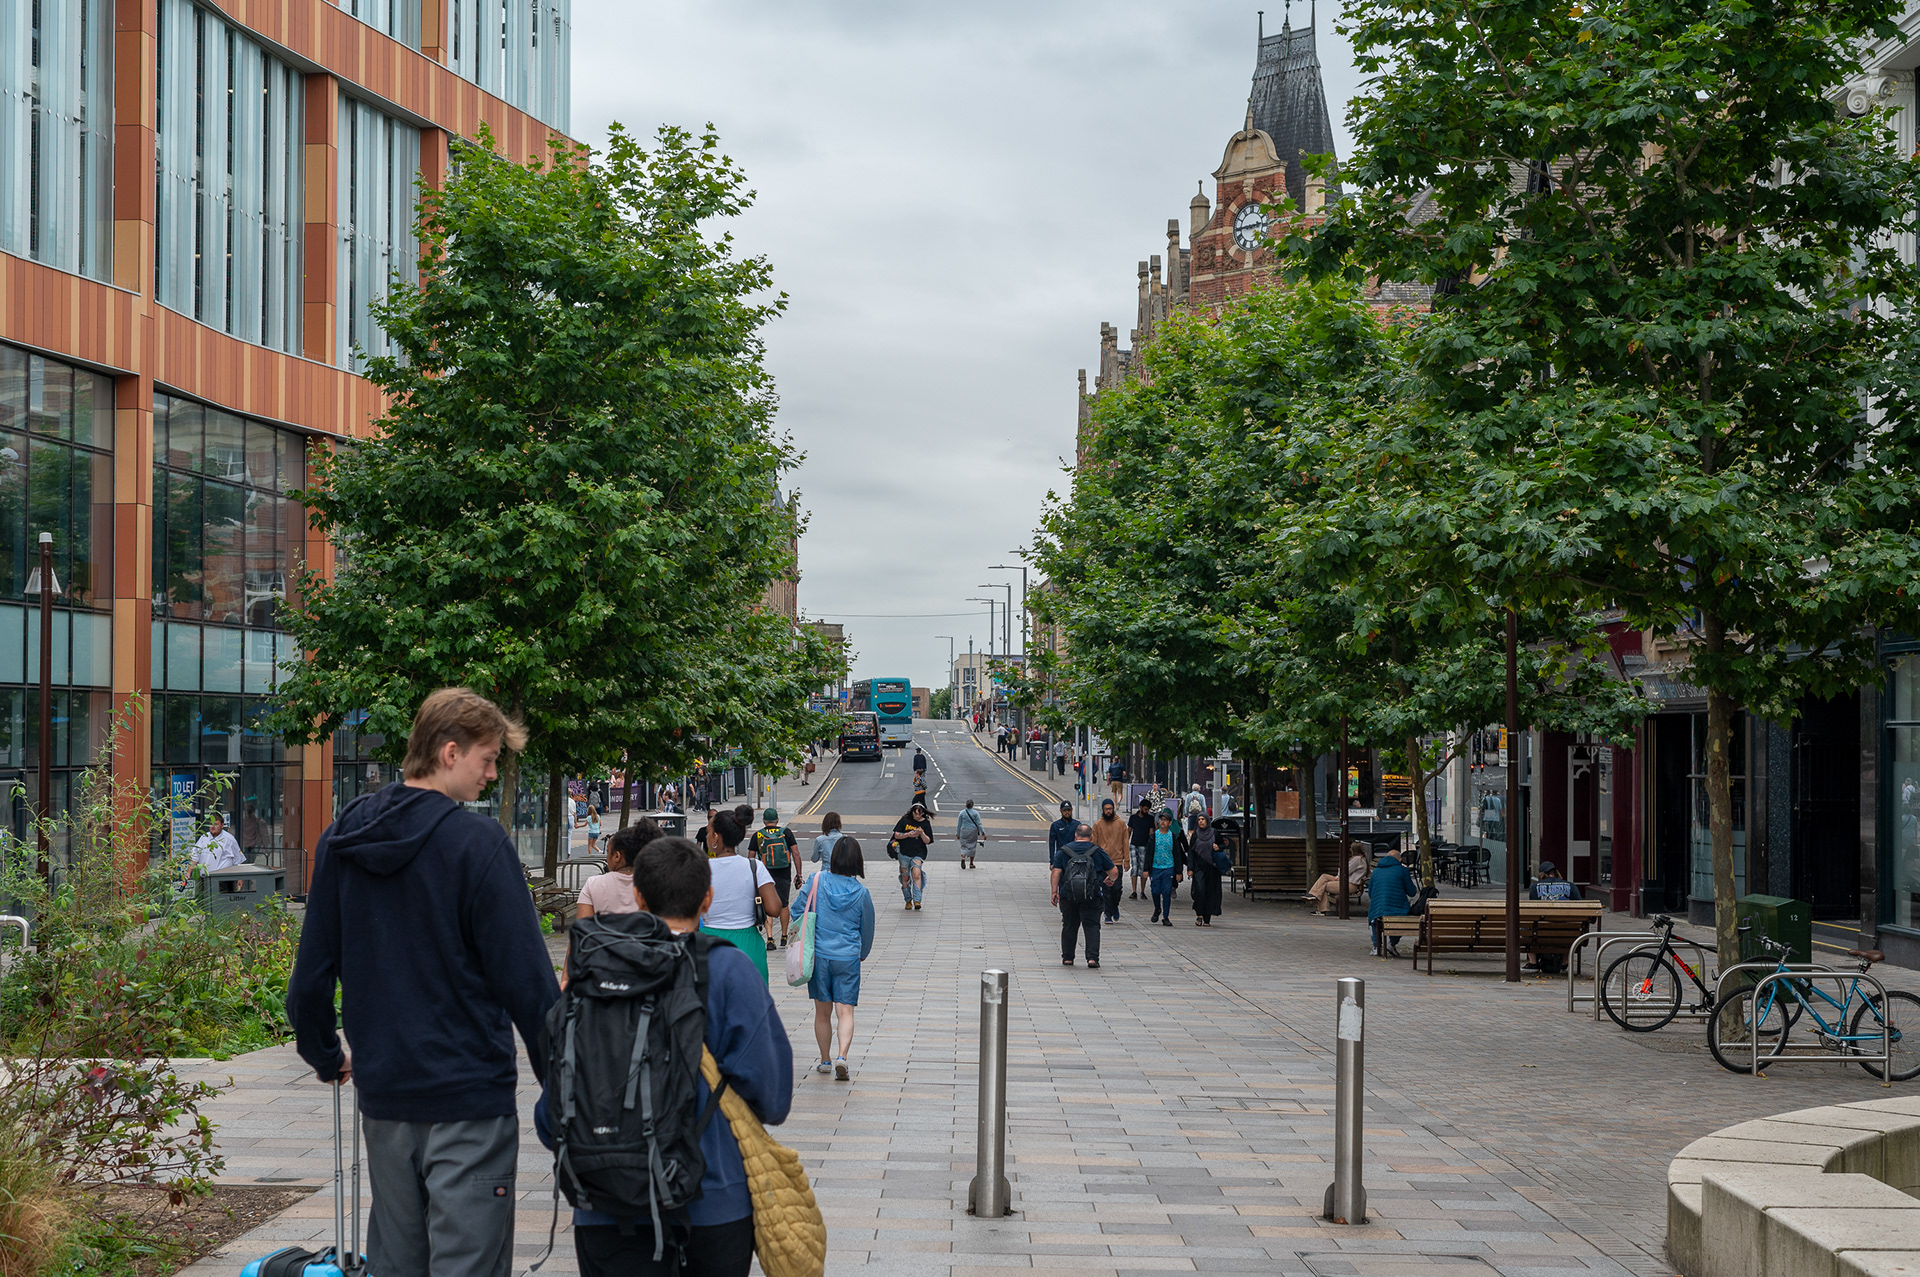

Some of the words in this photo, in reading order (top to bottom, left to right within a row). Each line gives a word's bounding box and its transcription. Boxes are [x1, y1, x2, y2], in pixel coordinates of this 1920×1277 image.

[173, 781, 182, 793] TO
[183, 781, 194, 792] LET
[1672, 954, 1695, 979] PINNACLE
